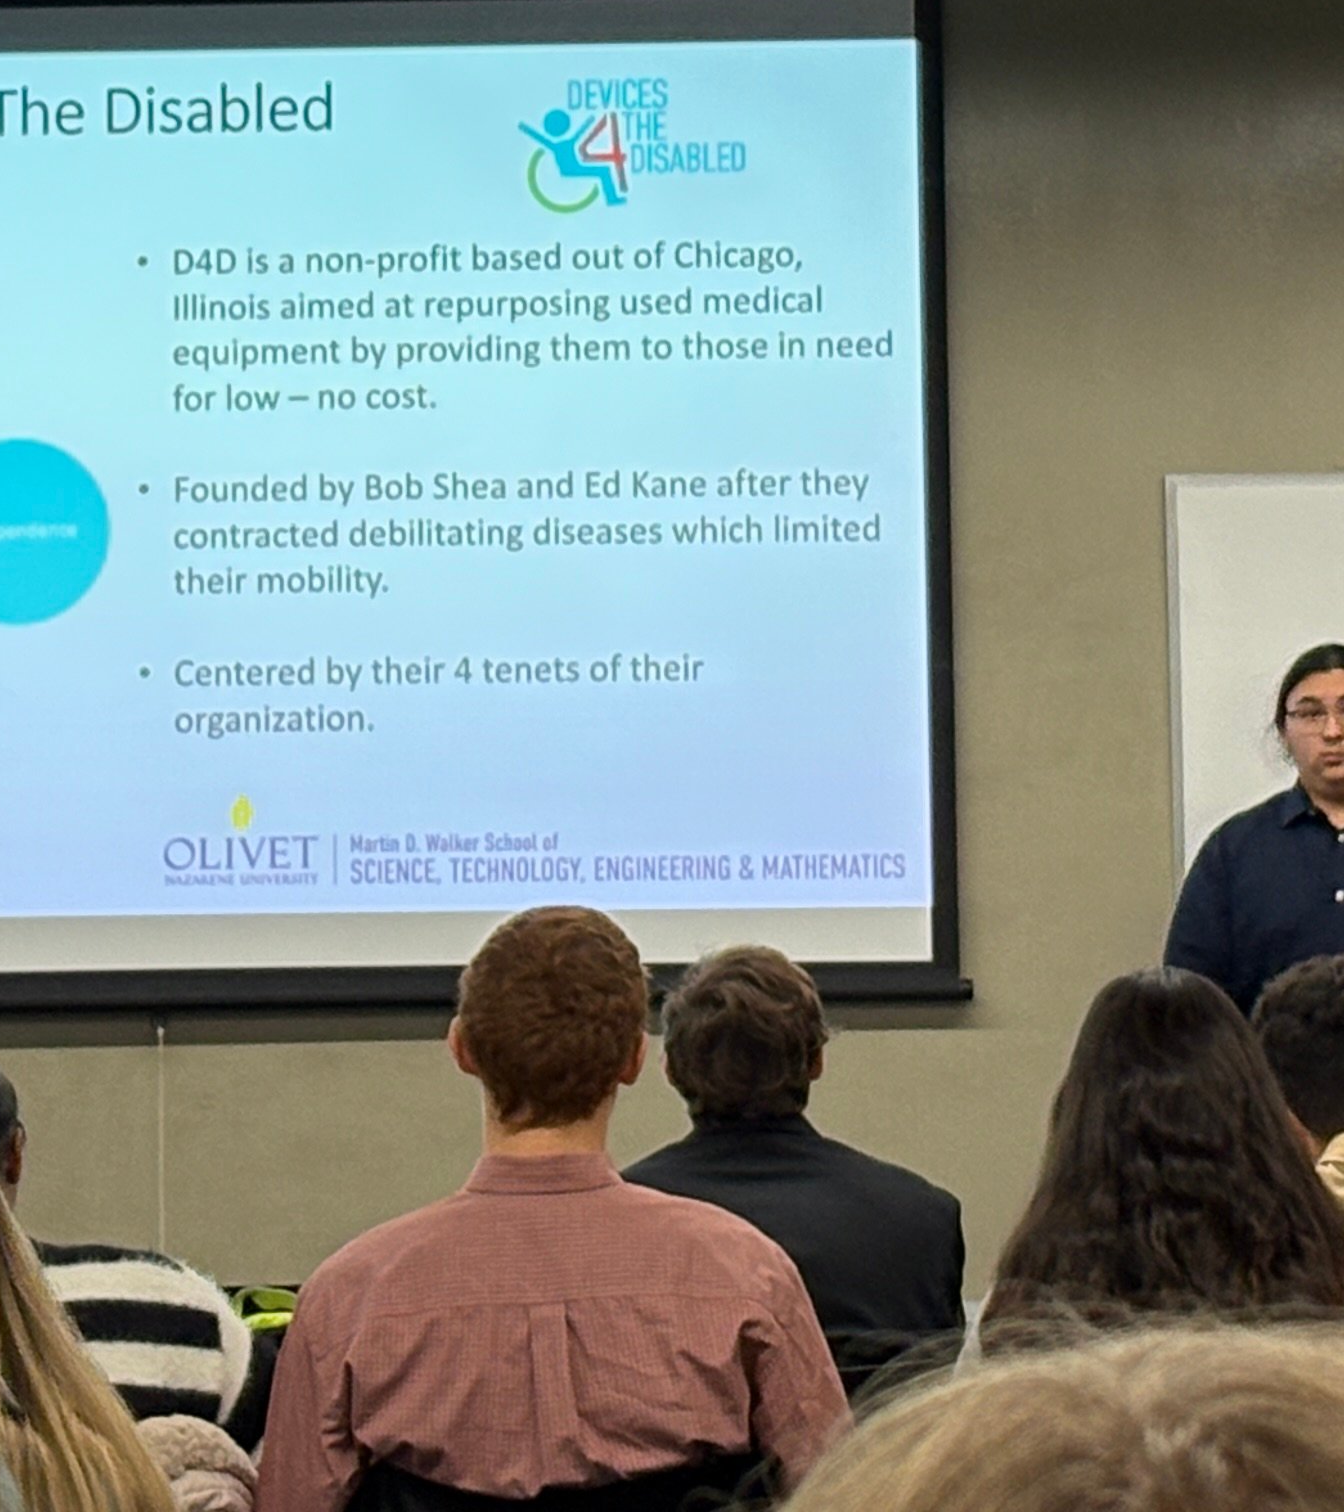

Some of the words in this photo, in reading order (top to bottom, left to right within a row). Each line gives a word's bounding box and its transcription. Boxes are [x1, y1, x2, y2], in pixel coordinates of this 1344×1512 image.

[106, 80, 333, 135] Disabled
[567, 78, 669, 110] DEVICES
[622, 111, 667, 141] THE
[578, 111, 629, 193] 4
[630, 142, 746, 174] DISABLED
[173, 248, 237, 276] D4D
[247, 246, 269, 275] is
[278, 253, 295, 275] a
[306, 243, 462, 279] non-profit
[471, 241, 561, 272] based
[572, 245, 624, 270] out
[633, 240, 666, 270] of
[674, 240, 803, 274] Chicago,
[173, 293, 271, 321] Illinois
[280, 290, 375, 320] aimed
[384, 293, 415, 319] at
[424, 287, 611, 324] repurposing
[620, 286, 692, 316] used
[703, 284, 823, 315] medical
[172, 338, 341, 372] equipment
[351, 335, 387, 371] by
[396, 333, 541, 370] providing
[550, 332, 631, 362] them
[641, 335, 673, 361] to
[682, 330, 768, 361] those
[778, 330, 805, 359] in
[816, 329, 893, 359] need
[173, 383, 217, 413] for
[226, 383, 281, 412] low
[318, 389, 356, 411] no
[365, 384, 437, 410] cost.
[174, 472, 308, 504] Founded
[319, 472, 355, 508] by
[365, 471, 424, 501] Bob
[432, 471, 507, 501] Shea
[517, 470, 574, 499] and
[585, 469, 621, 499] Ed
[632, 470, 707, 499] Kane
[717, 467, 792, 497] after
[801, 467, 869, 502] they
[173, 519, 339, 551] contracted
[348, 518, 524, 553] debilitating
[533, 517, 663, 546] diseases
[671, 514, 763, 545] which
[774, 513, 881, 543] limited
[174, 566, 248, 596] their
[257, 564, 389, 600] mobility.
[174, 656, 315, 687] Centered
[326, 656, 363, 693] by
[371, 655, 446, 685] their
[454, 656, 472, 684] 4
[482, 657, 580, 684] tenets
[589, 652, 622, 683] of
[630, 653, 705, 682] their
[174, 703, 375, 740] organization.
[163, 835, 319, 871] OLIVET
[350, 835, 400, 853] Martin
[405, 834, 420, 853] D.
[426, 835, 479, 852] Walker
[485, 833, 536, 852] School
[543, 833, 558, 851] of
[350, 858, 440, 885] SCIENCE,
[450, 857, 584, 884] TECHNOLOGY,
[594, 855, 731, 881] ENGINEERING
[739, 855, 754, 880] &
[762, 854, 905, 879] MATHEMATICS
